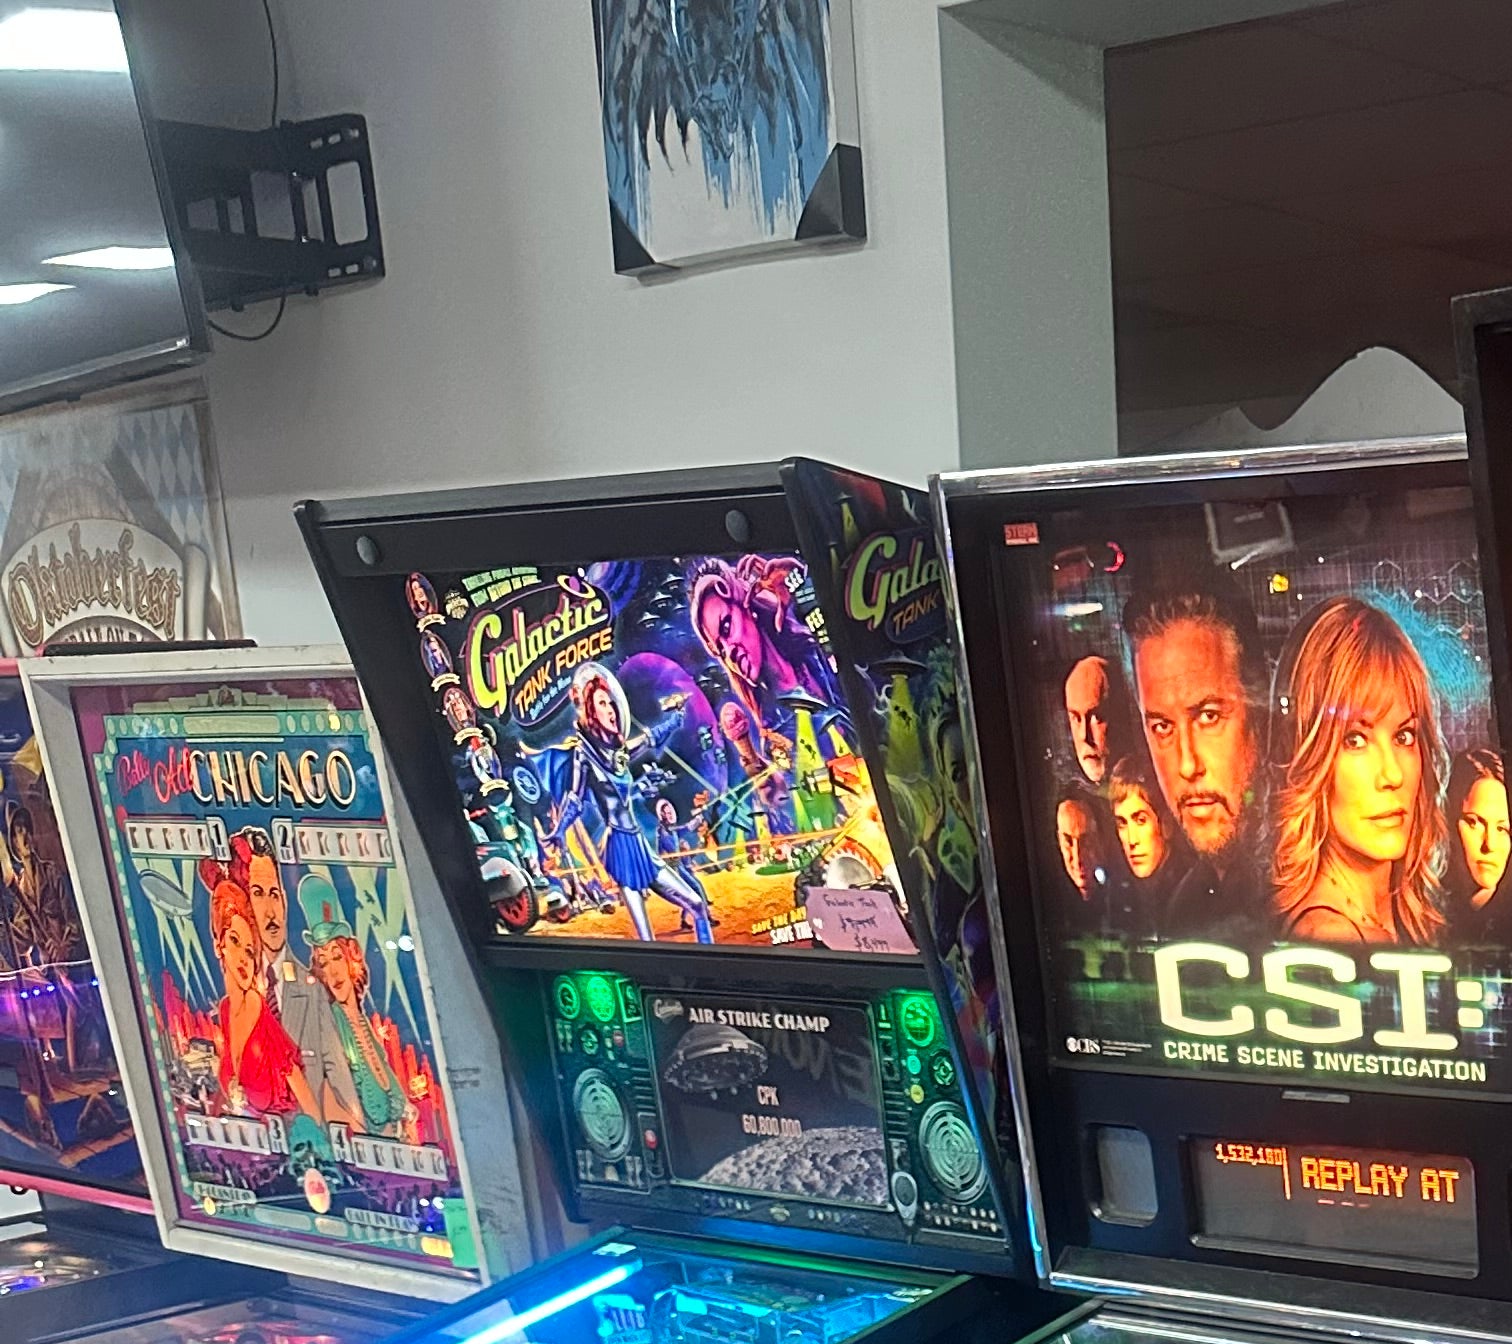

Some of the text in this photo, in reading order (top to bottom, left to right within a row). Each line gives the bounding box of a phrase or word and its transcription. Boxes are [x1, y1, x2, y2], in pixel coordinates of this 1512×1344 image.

[8, 522, 181, 646] Oktoberfest
[848, 535, 943, 630] Gala
[893, 590, 940, 636] TANK
[467, 593, 609, 718] Galactic
[515, 659, 552, 719] TANK
[555, 626, 613, 676] FORCE
[190, 748, 357, 807] CHICAGO
[752, 918, 772, 935] SAVE
[769, 925, 795, 945] SAVE
[687, 1006, 716, 1026] AIR
[717, 1009, 772, 1030] STRIKE
[774, 1012, 831, 1034] CHAMP
[1153, 941, 1485, 1051] CSI:
[1163, 1040, 1230, 1064] CRIME
[1237, 1045, 1305, 1070] SCENE
[1313, 1050, 1487, 1082] INVESTIGATION
[756, 1085, 780, 1107] CPK
[1300, 1155, 1460, 1203] REPLAY AT
